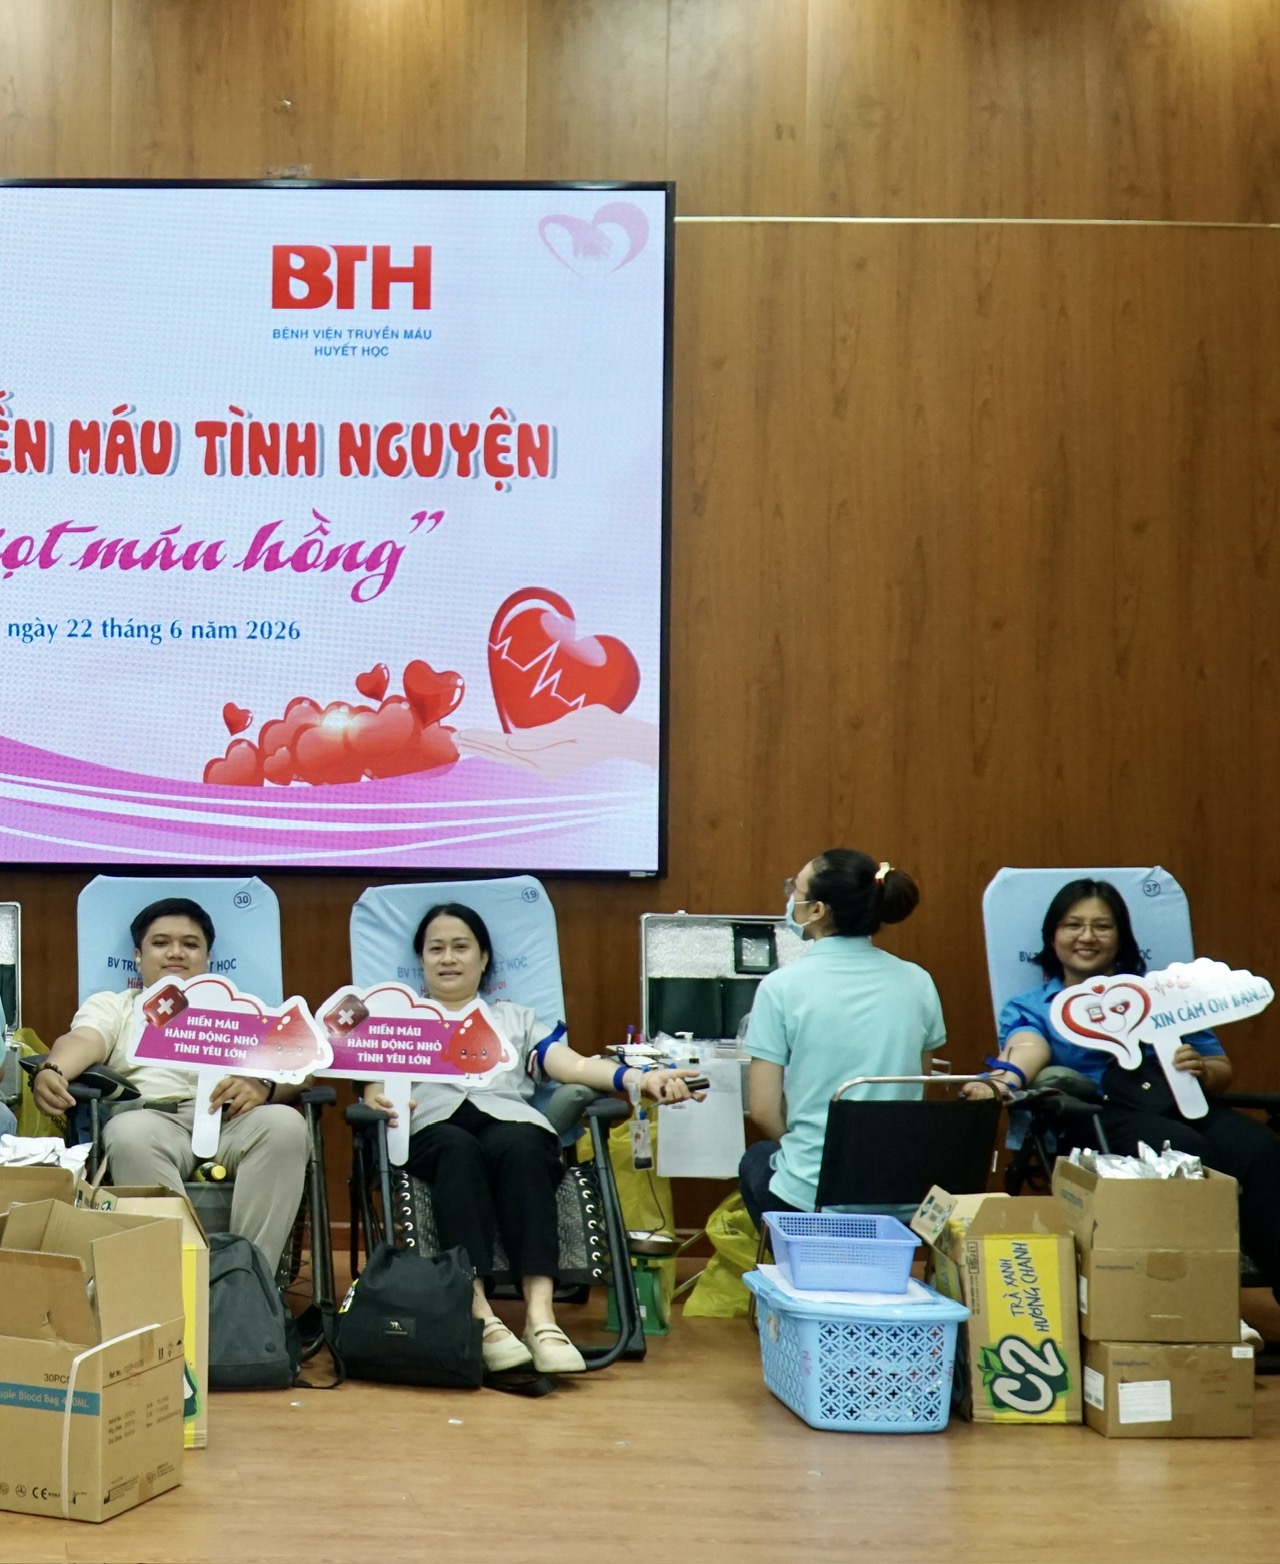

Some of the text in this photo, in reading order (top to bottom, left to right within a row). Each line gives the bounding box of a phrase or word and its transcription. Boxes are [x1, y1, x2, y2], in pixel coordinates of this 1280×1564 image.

[271, 244, 433, 310] BTH
[272, 325, 433, 341] BỆNH VIỆN TRUYỀN MÁU
[314, 342, 389, 358] HUYẾT HỌC
[68, 403, 181, 479] MÁU
[195, 404, 324, 480] TÌNH
[338, 404, 558, 494] NGUYỆN
[70, 524, 227, 574] máu
[7, 617, 58, 644] ngày
[66, 618, 93, 638] 22
[101, 616, 163, 645] tháng
[170, 619, 183, 639] 6
[191, 620, 238, 640] năm
[245, 619, 301, 641] 2026
[525, 889, 537, 899] 19
[1146, 882, 1158, 893] 37
[236, 895, 249, 905] 30
[107, 957, 120, 969] BV
[216, 958, 237, 974] HỌC
[397, 966, 410, 979] BV
[187, 1014, 239, 1031] HIẾN MÁU
[1150, 1011, 1176, 1029] XIN
[1177, 1000, 1207, 1022] CẢM
[165, 1026, 259, 1046] HÀNH ĐỘNG NHỎ
[368, 1021, 422, 1037] HIẾN MÁU
[173, 1042, 247, 1060] TÌNH YÊU LỚN
[347, 1035, 442, 1054] HÀNH ĐỘNG NHỎ
[357, 1050, 431, 1065] TÌNH YÊU LỚN
[1011, 1242, 1039, 1284] CHANH
[999, 1258, 1025, 1318] TRÀ XANH
[991, 1334, 1066, 1415] C2
[18, 1390, 42, 1403] Blood
[44, 1393, 60, 1407] Bag
